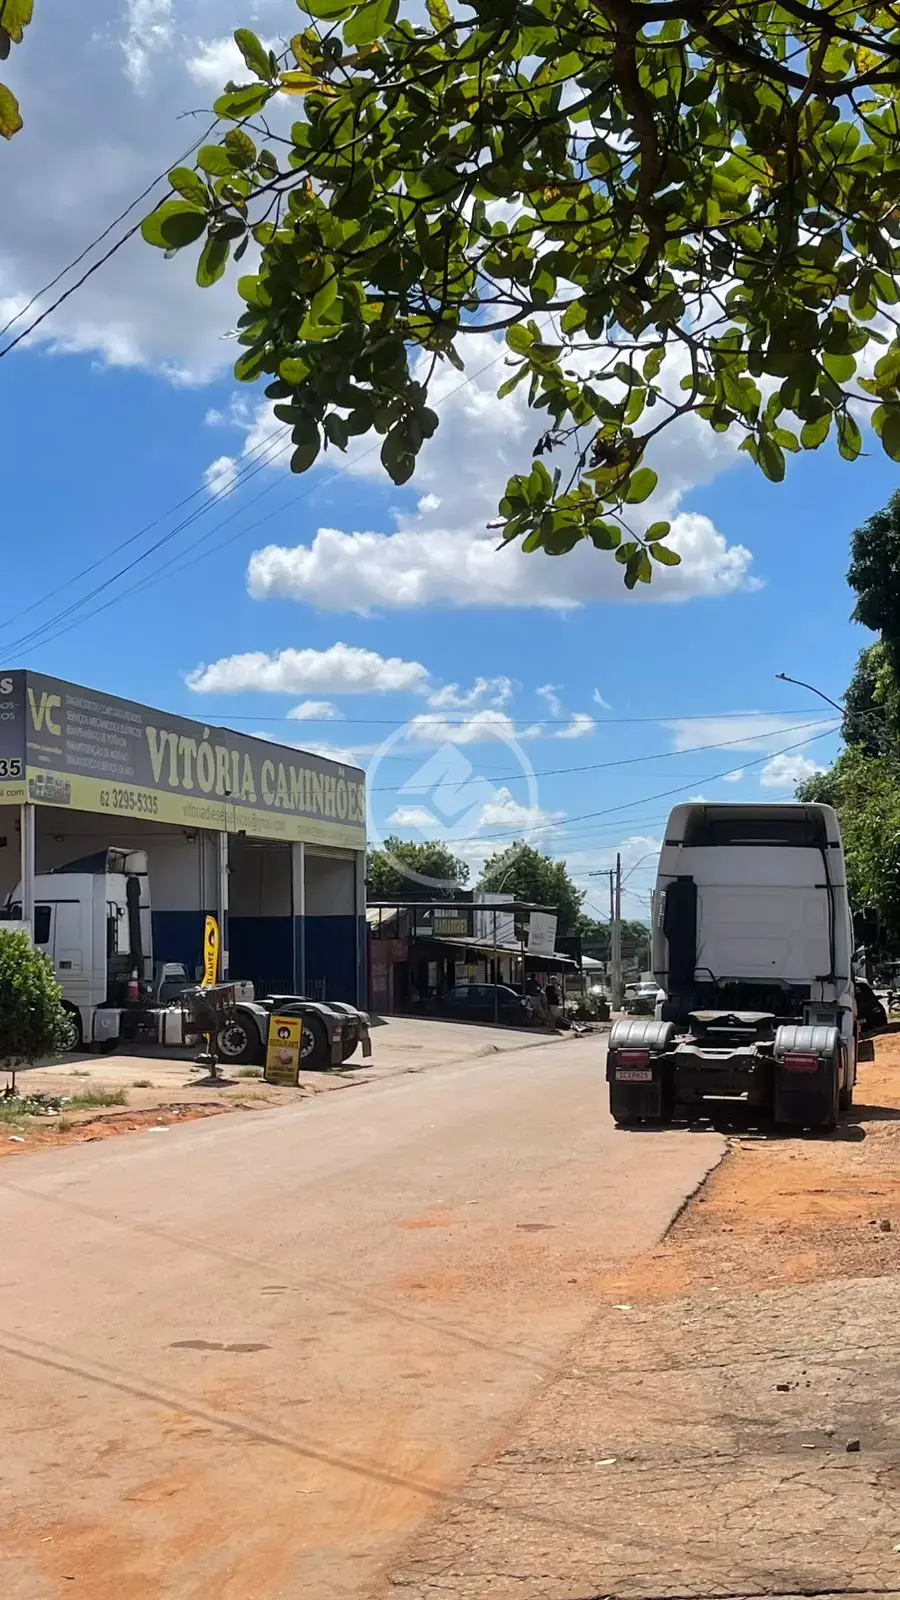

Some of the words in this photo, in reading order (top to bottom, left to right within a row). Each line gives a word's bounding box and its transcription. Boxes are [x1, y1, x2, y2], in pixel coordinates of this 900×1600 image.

[27, 687, 61, 736] VC
[145, 726, 257, 803] VITÓRIA
[260, 759, 365, 823] CAMINHÕES
[100, 790, 109, 807] 62
[112, 788, 158, 815] 3295-5335
